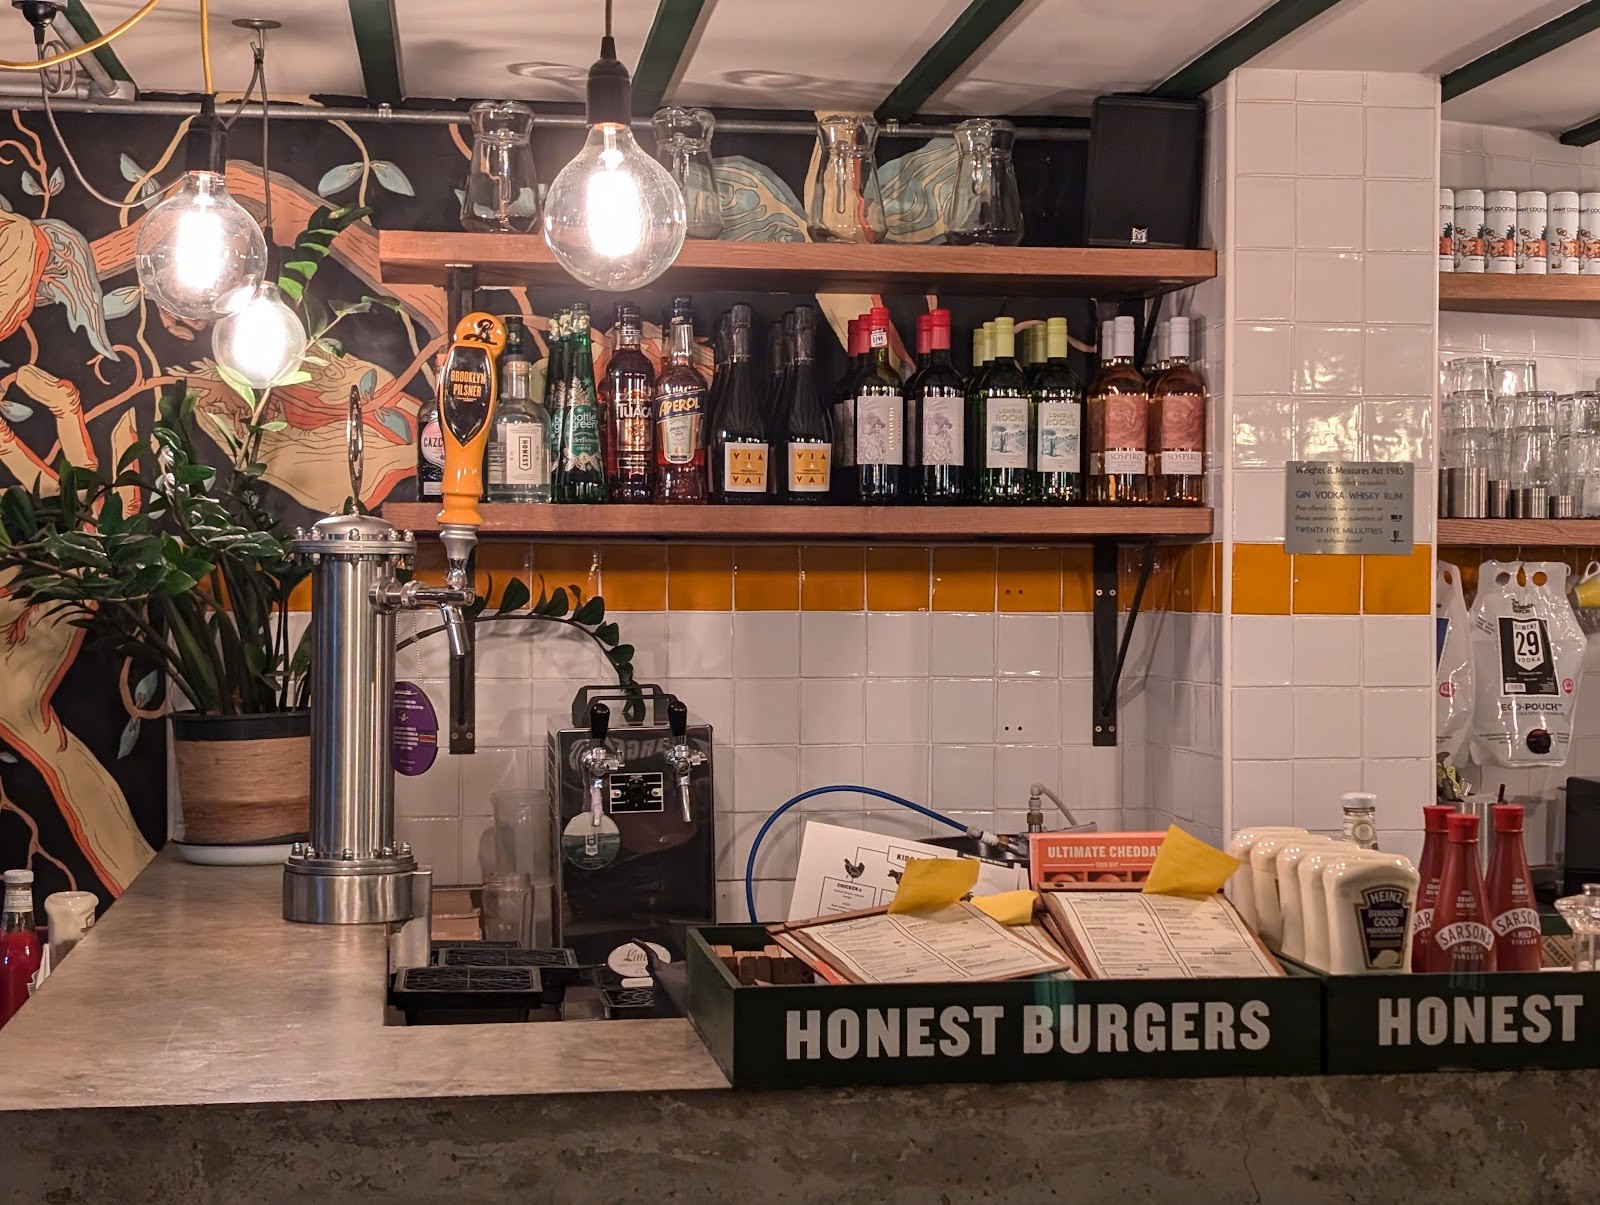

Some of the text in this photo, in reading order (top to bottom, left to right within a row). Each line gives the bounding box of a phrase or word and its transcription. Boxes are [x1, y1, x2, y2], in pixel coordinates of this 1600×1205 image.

[450, 370, 487, 385] BROOKLYN
[453, 384, 482, 398] PILSNER
[658, 397, 701, 418] APEROL
[733, 452, 763, 461] VIA
[796, 452, 826, 460] VIA
[1110, 453, 1143, 461] SOSPIRO
[1167, 453, 1200, 461] SOSPIRO
[1295, 466, 1325, 476] Weights
[1335, 467, 1369, 475] Measures
[1371, 467, 1384, 475] Act
[1386, 467, 1404, 475] 1985
[733, 476, 761, 484] VAI
[796, 476, 825, 484] VAI
[1296, 491, 1403, 500] GIN VODKA WHISKY RUM
[1295, 526, 1383, 535] TWENTY-FIVE MILLILITRES
[1515, 631, 1540, 656] 29
[1047, 846, 1106, 858] ULTIMATE
[837, 883, 859, 891] CHICKEN
[1370, 891, 1403, 904] HEINZ
[1373, 917, 1399, 927] GOOD
[1440, 924, 1492, 947] SARSONS
[1378, 994, 1584, 1046] HONEST
[785, 1001, 1270, 1060] HONEST BURGERS
